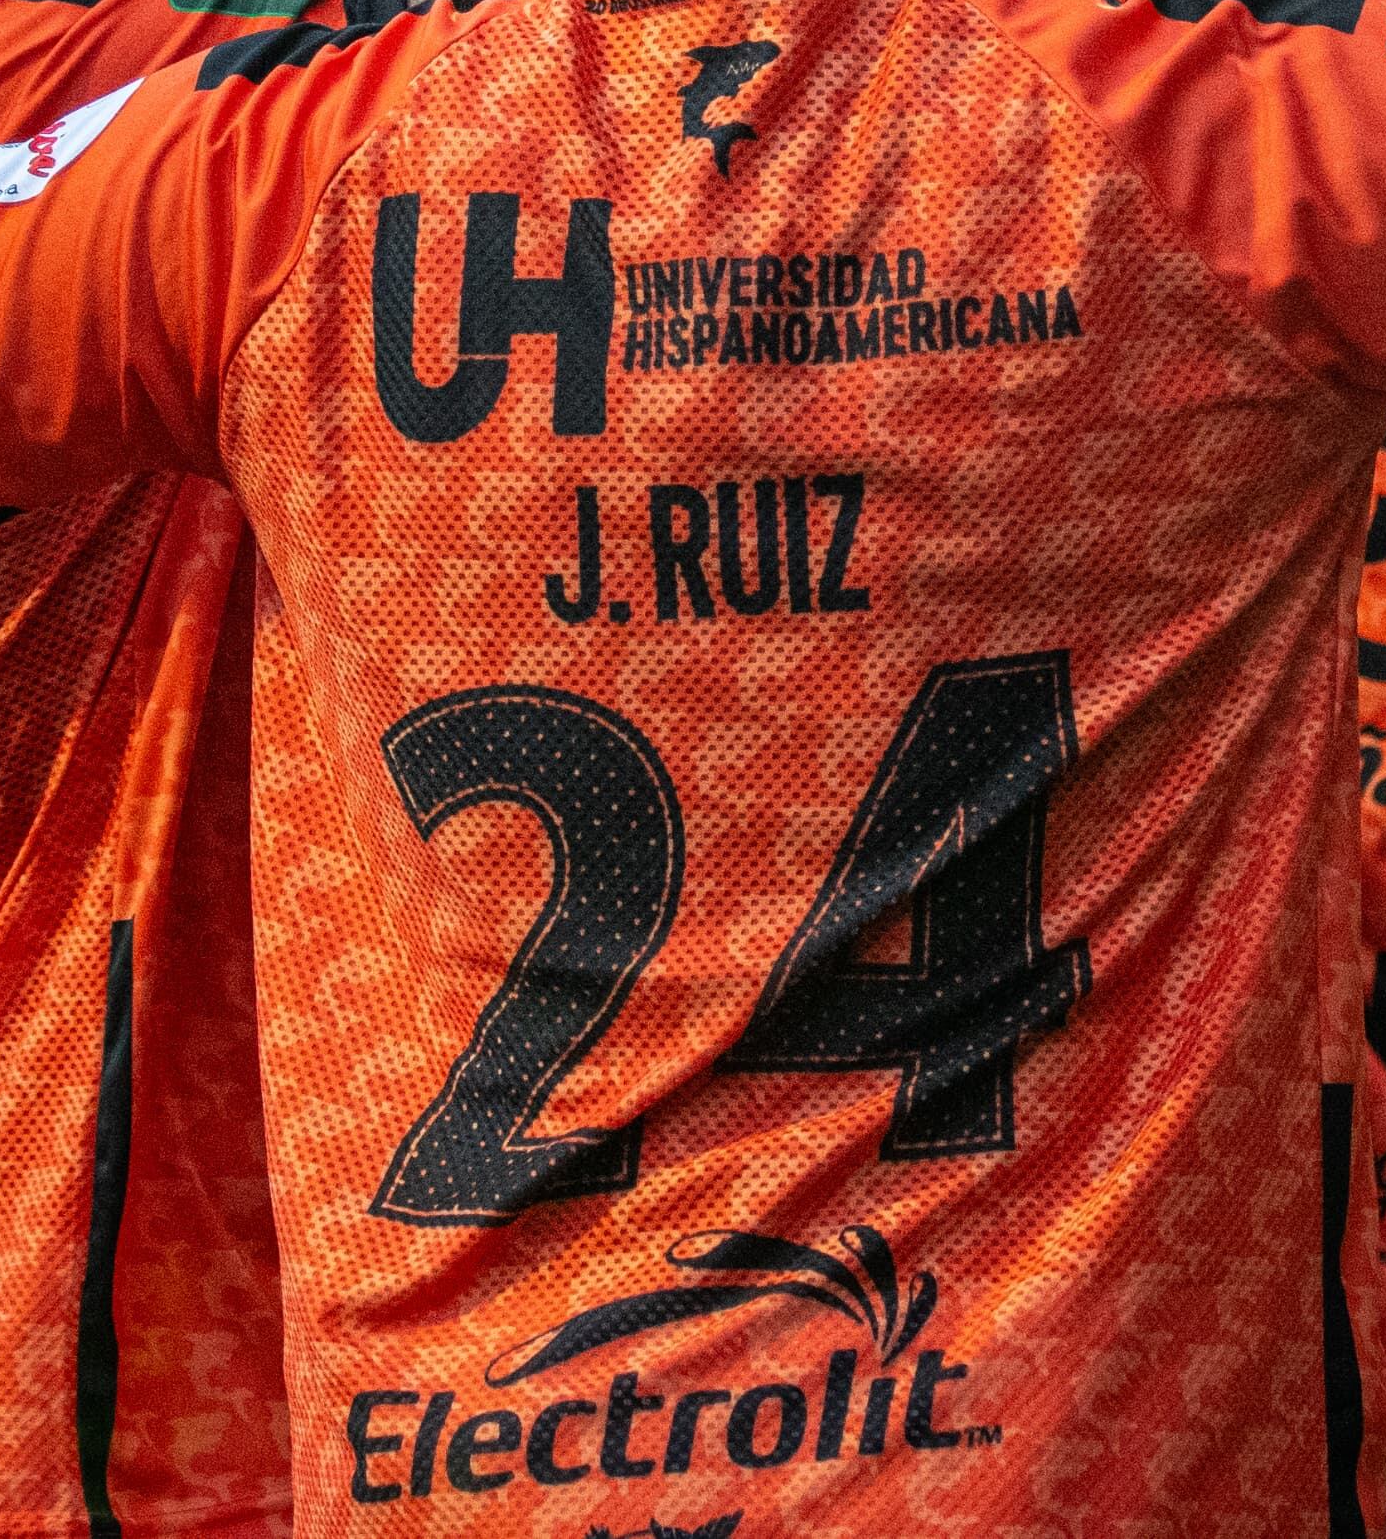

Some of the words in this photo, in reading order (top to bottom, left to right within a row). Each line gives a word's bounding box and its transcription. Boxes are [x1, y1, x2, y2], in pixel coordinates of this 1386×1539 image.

[372, 191, 614, 444] UH
[621, 284, 1084, 372] HISPANOAMERICANA
[622, 246, 928, 317] UNIVERSIDAD
[648, 472, 873, 622] RUIZ
[367, 647, 1093, 1230] 24
[346, 1348, 969, 1505] Electrolit
